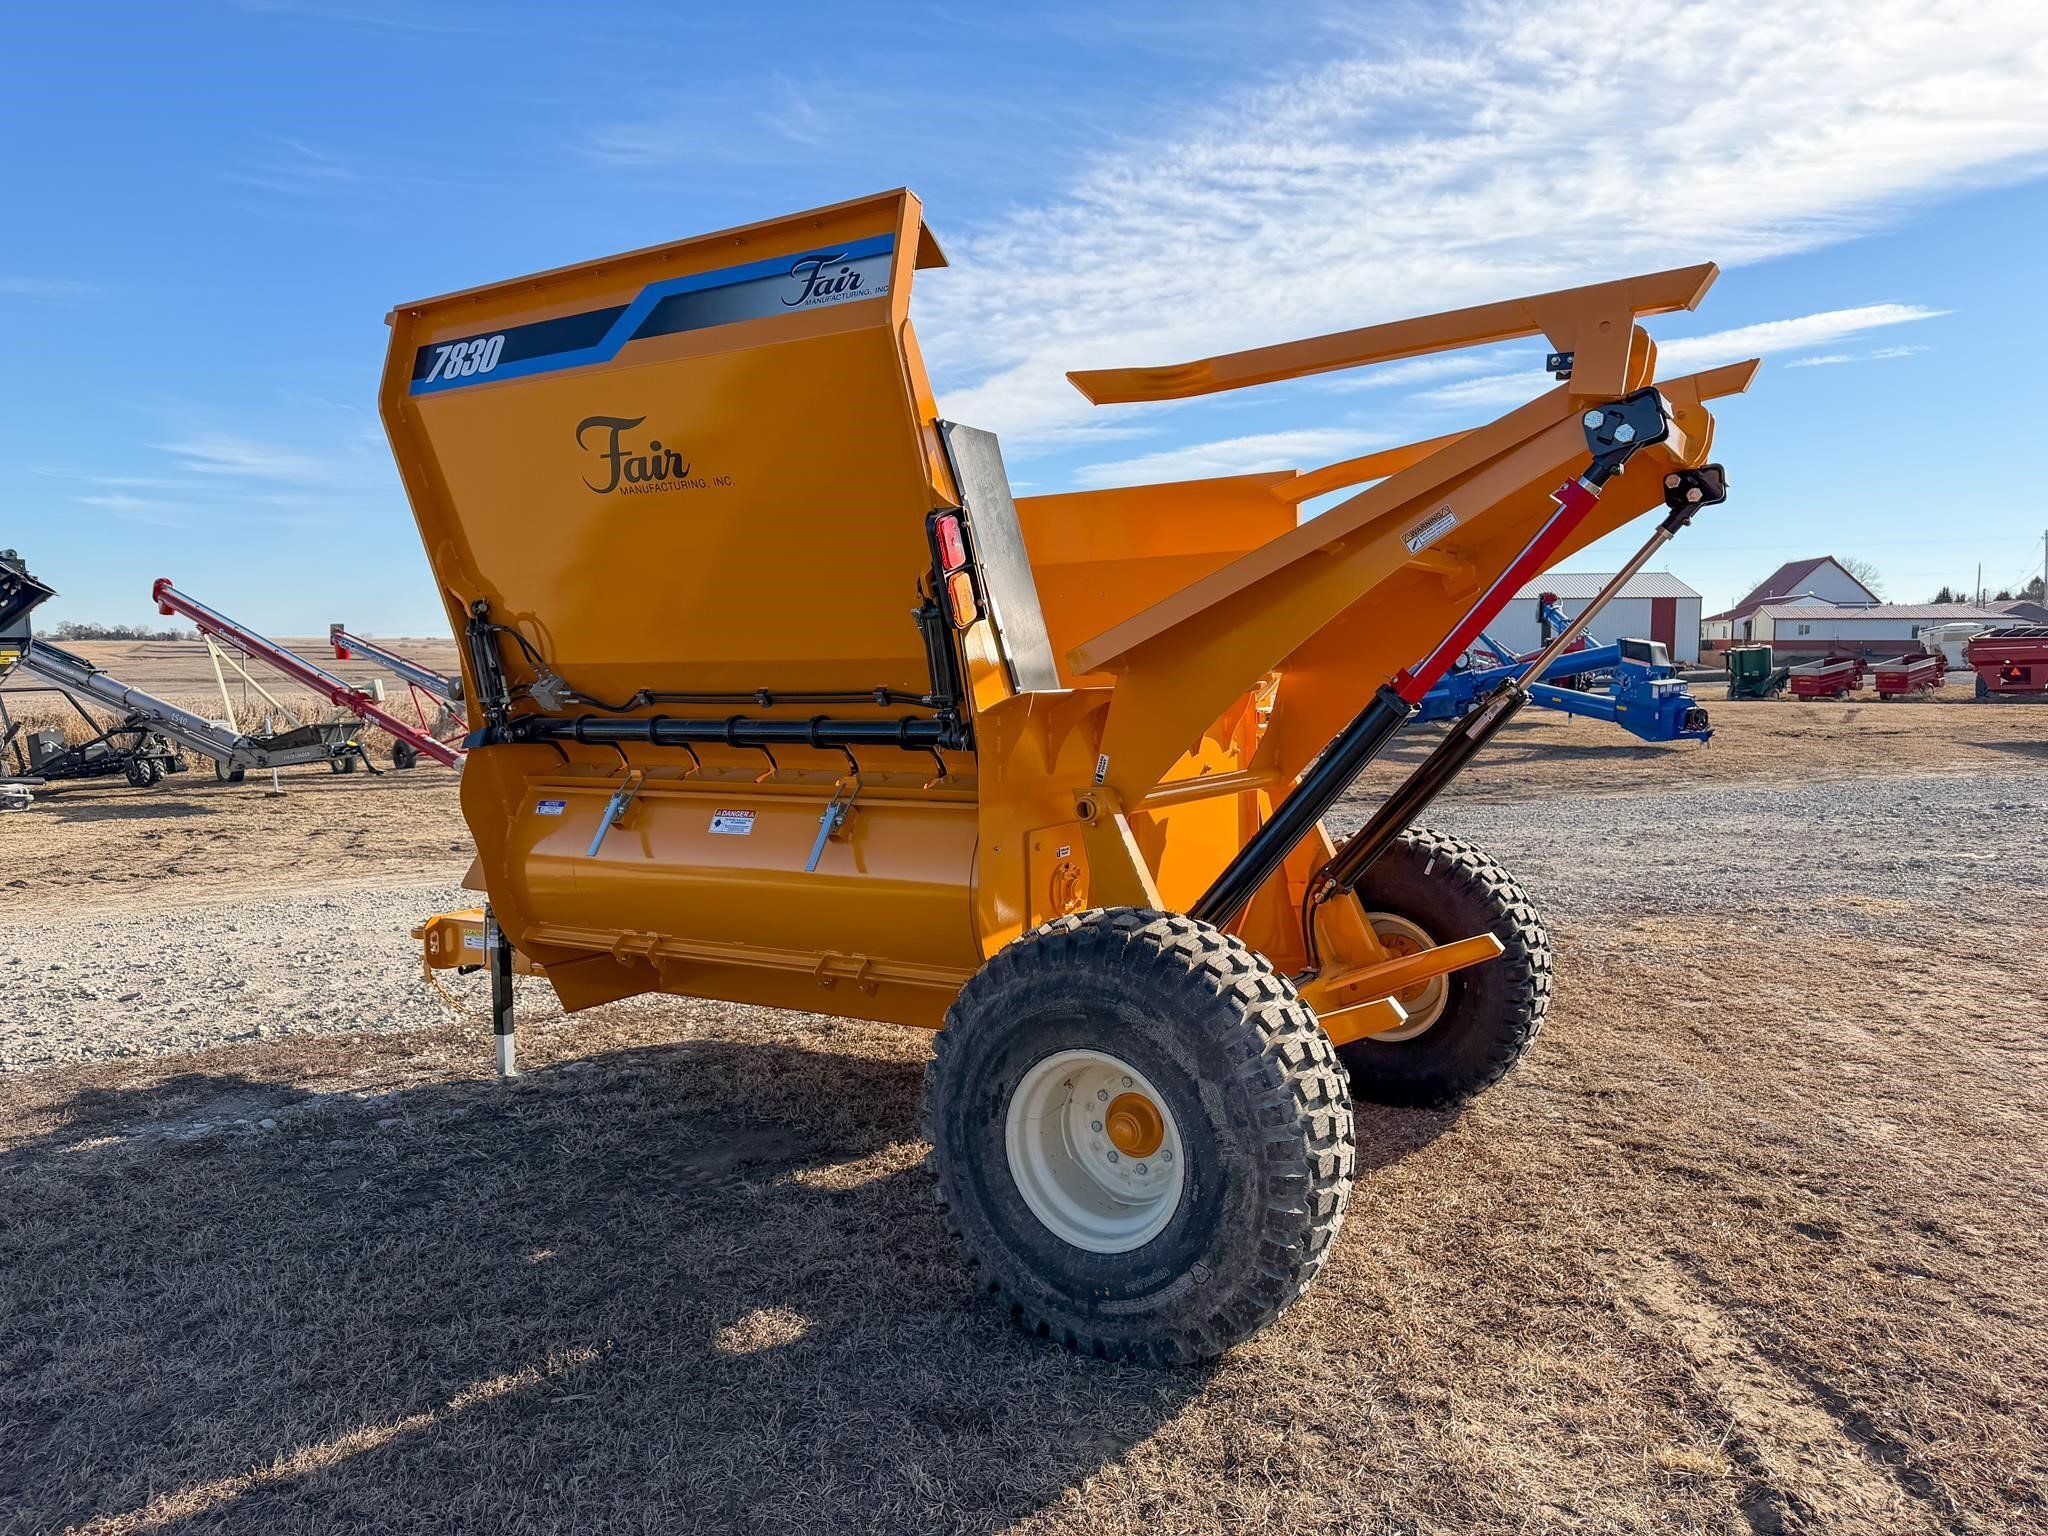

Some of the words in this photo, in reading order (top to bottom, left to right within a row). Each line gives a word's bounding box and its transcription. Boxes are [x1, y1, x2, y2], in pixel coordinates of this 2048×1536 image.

[781, 252, 864, 307] Fair
[804, 288, 872, 306] MANUFACTURING,
[425, 335, 505, 384] 7830
[576, 415, 691, 494] Fair
[619, 478, 710, 496] MANUFACTURING,
[712, 475, 736, 487] INC.
[1409, 512, 1444, 537] WARNING
